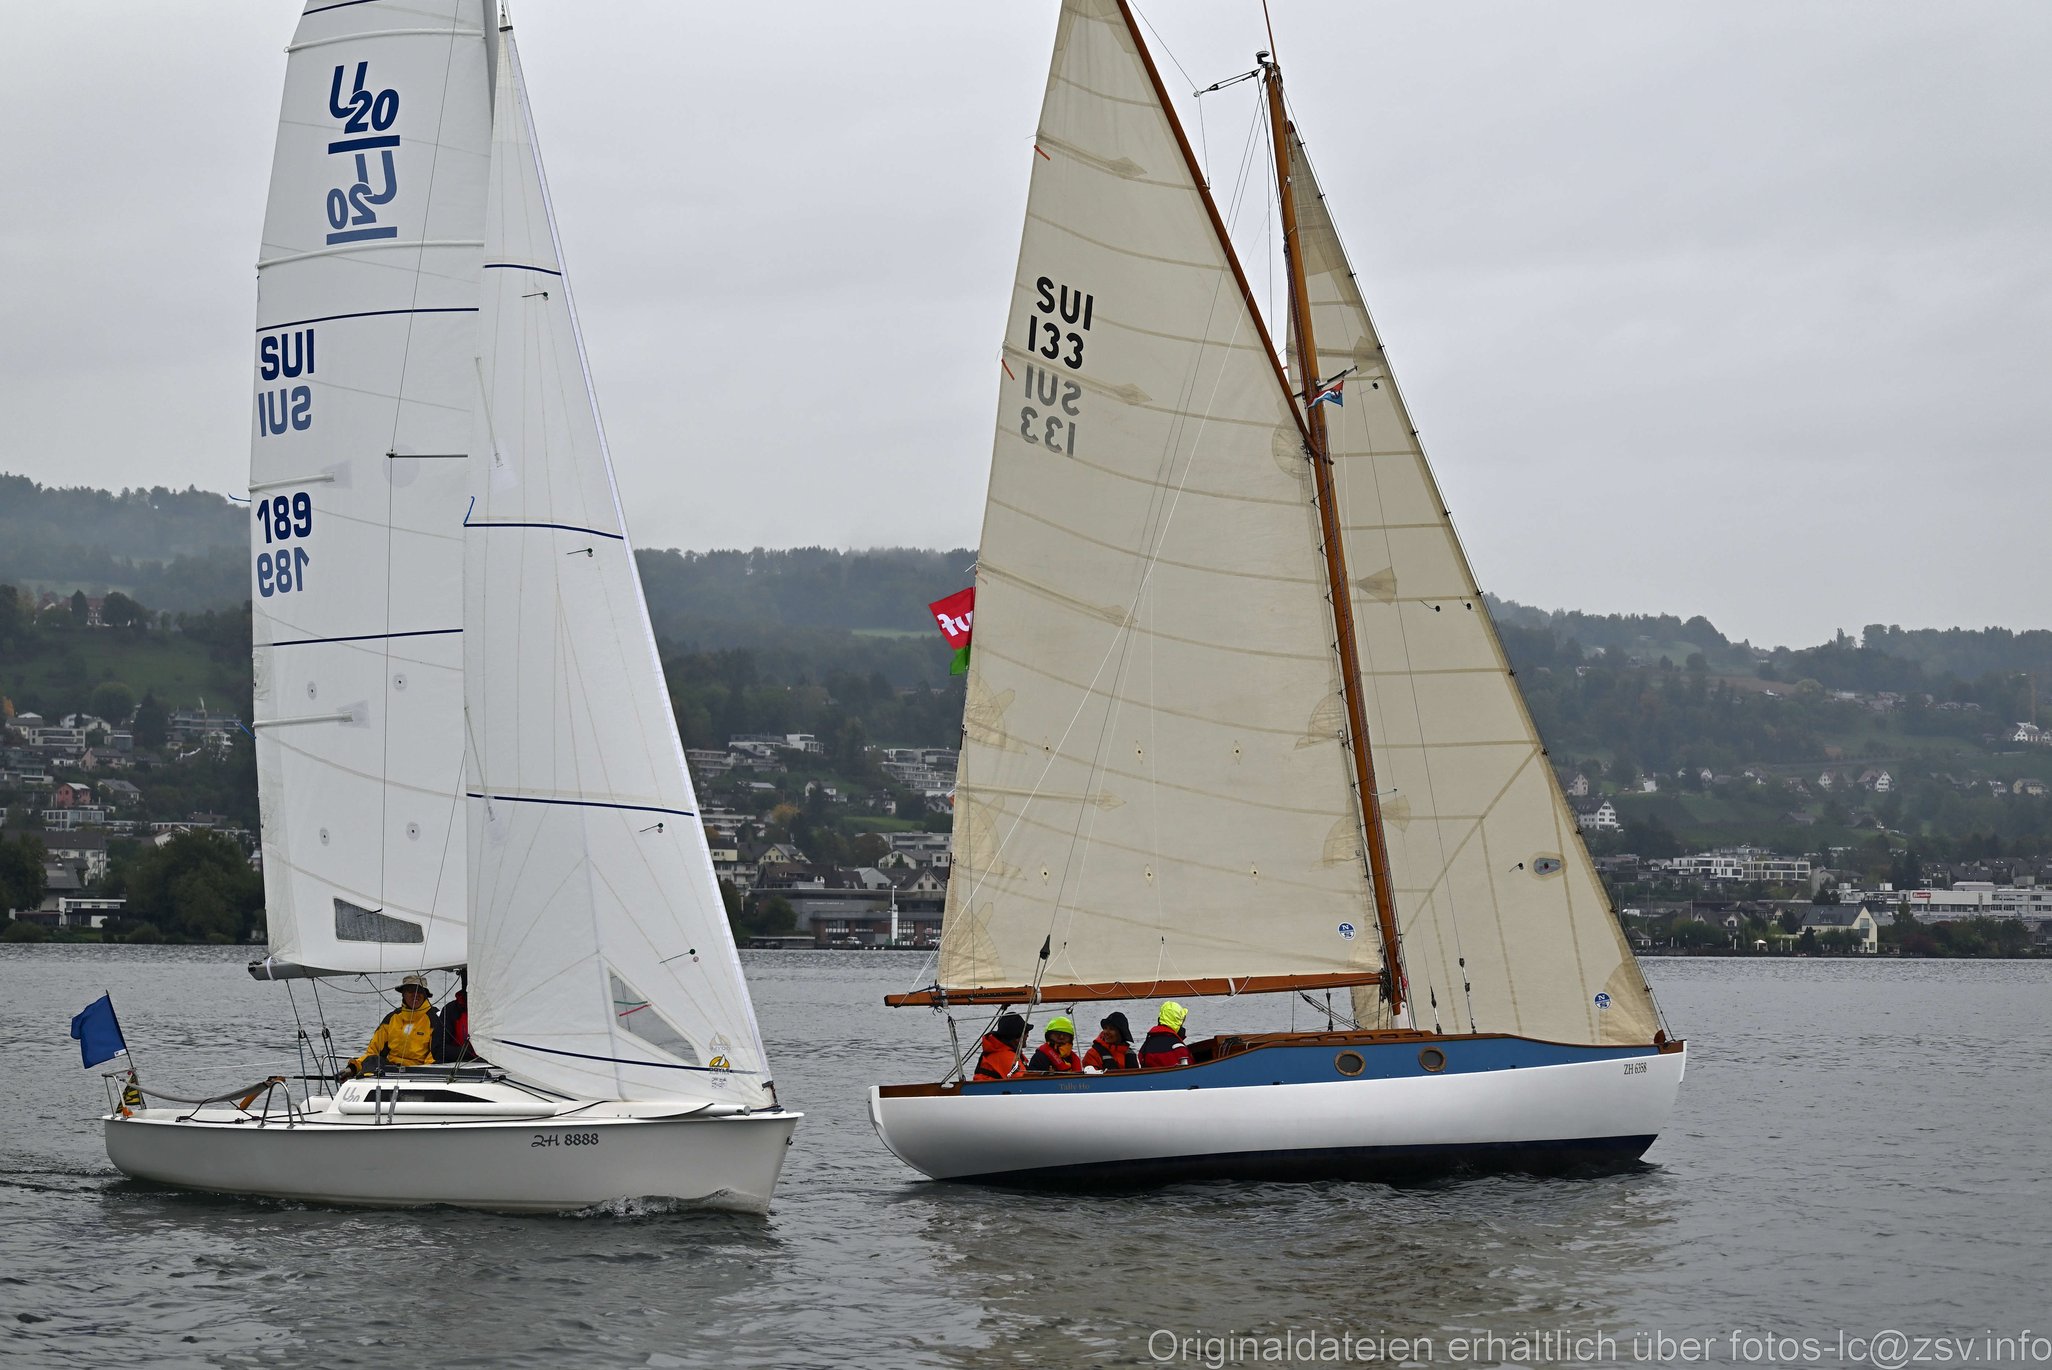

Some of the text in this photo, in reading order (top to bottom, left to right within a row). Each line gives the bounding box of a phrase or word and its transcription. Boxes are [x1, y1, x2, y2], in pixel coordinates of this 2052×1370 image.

[1036, 276, 1094, 331] SUI
[260, 328, 314, 381] SUI
[1028, 314, 1084, 370] 133
[256, 491, 312, 544] 189
[1623, 1063, 1634, 1075] ZH
[564, 1133, 599, 1146] 8888
